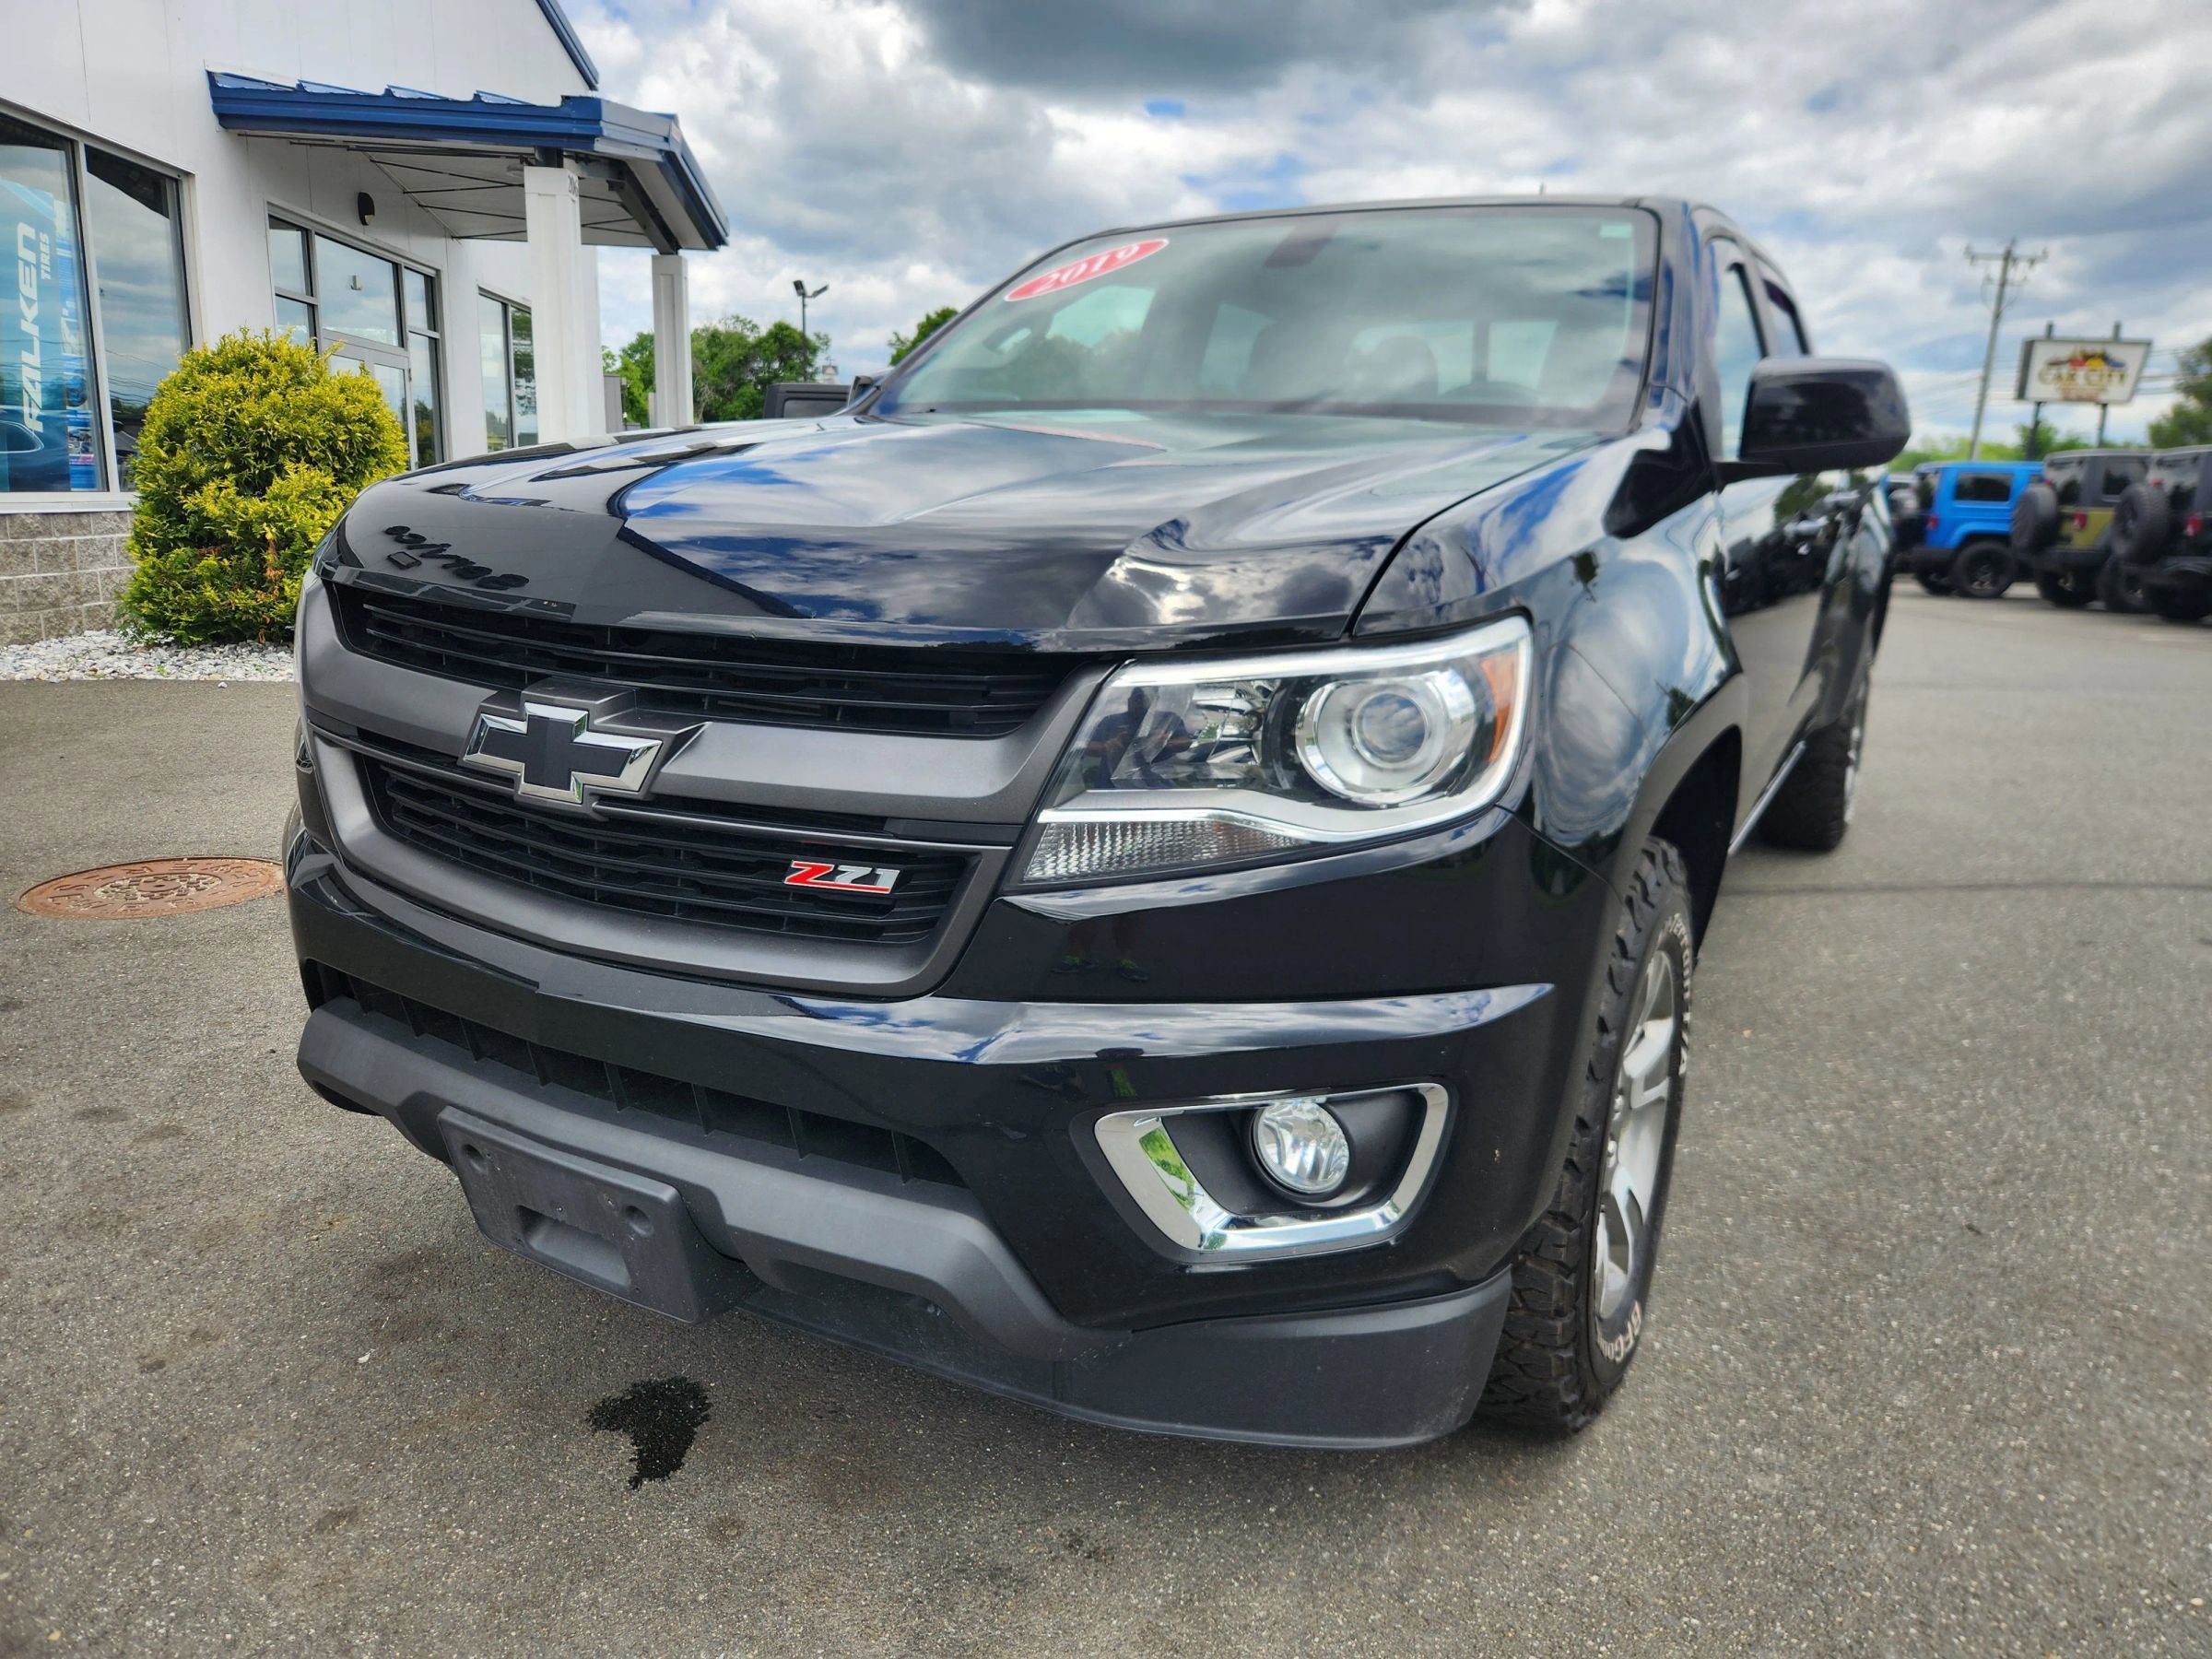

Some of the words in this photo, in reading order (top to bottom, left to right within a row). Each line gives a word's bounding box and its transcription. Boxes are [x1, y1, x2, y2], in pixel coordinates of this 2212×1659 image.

[39, 232, 52, 281] TIRES
[1033, 243, 1140, 295] 2019
[17, 221, 43, 433] FALKEN
[2037, 366, 2077, 385] CAR
[2083, 368, 2127, 387] CITY
[783, 860, 900, 894] Z71
